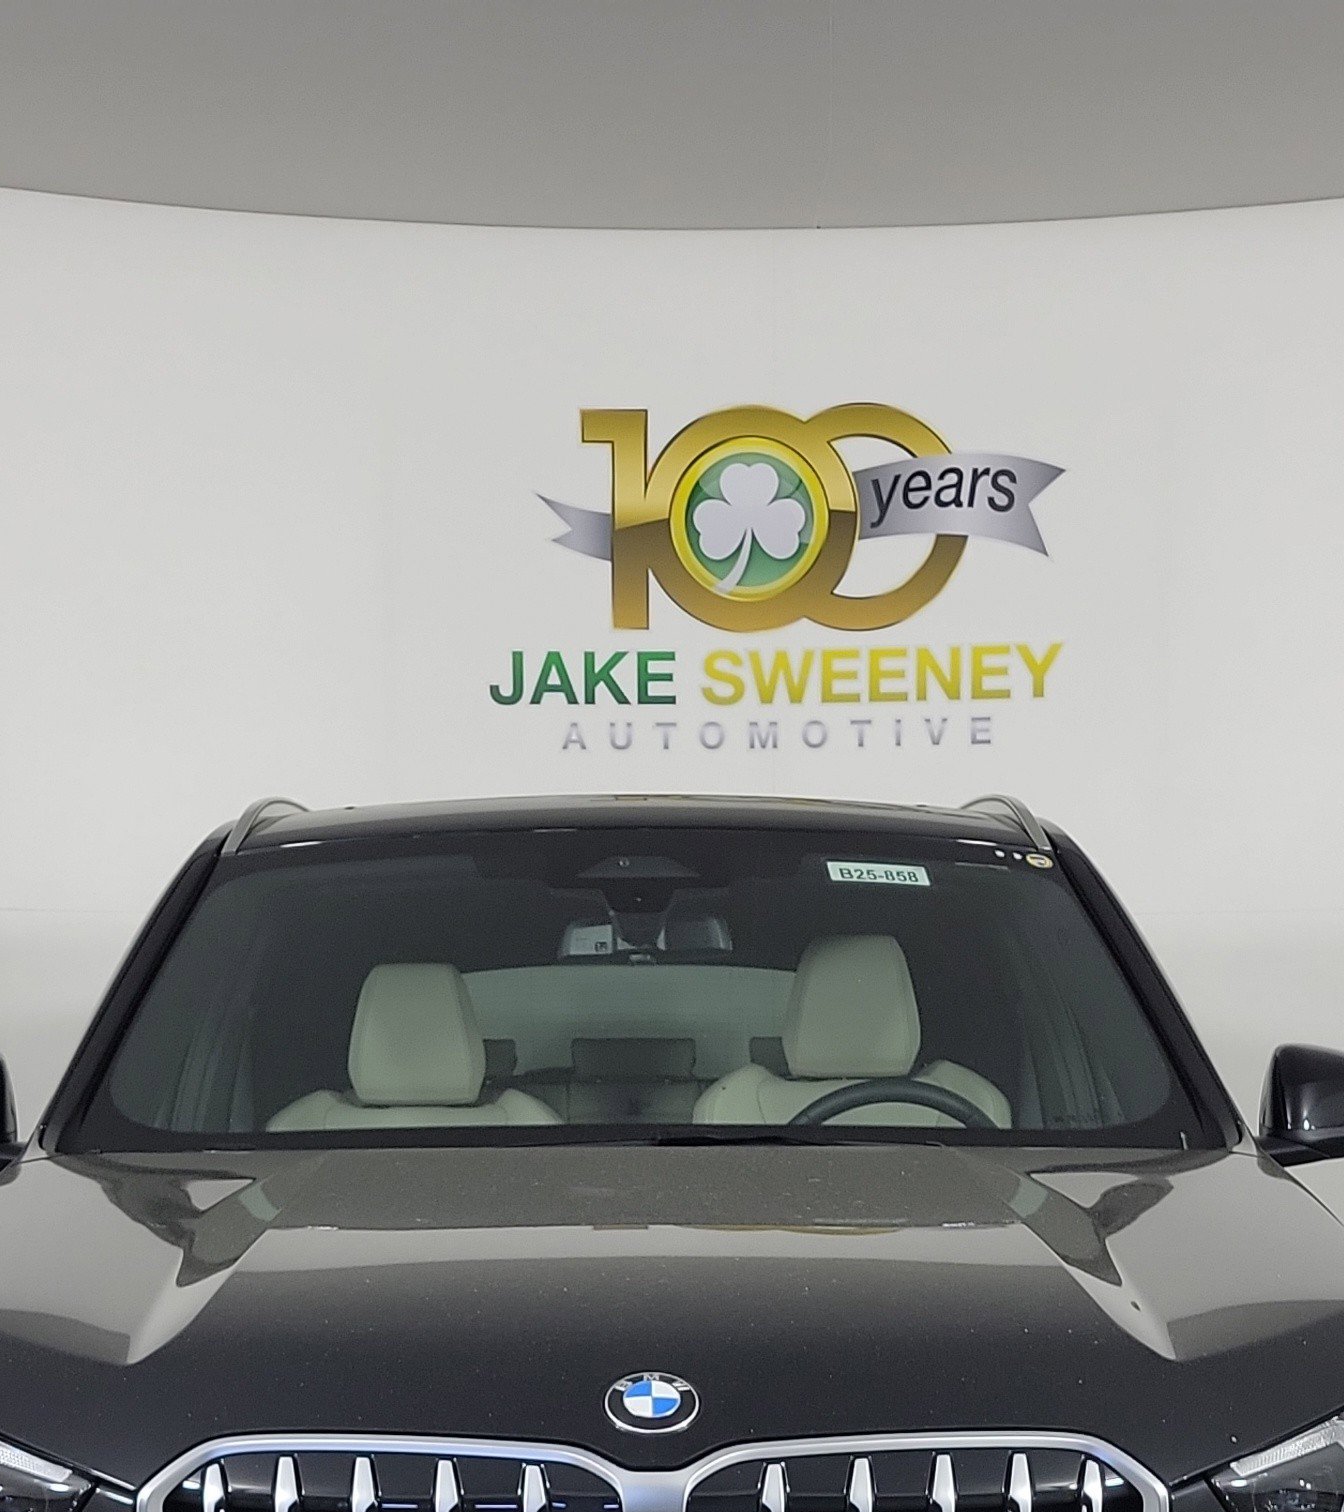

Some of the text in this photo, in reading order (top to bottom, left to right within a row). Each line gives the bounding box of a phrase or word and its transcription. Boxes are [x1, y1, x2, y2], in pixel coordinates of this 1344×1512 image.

[869, 466, 1017, 529] years
[489, 642, 1064, 706] JAKE SWEENEY
[561, 716, 993, 751] AUTOMOTIVE
